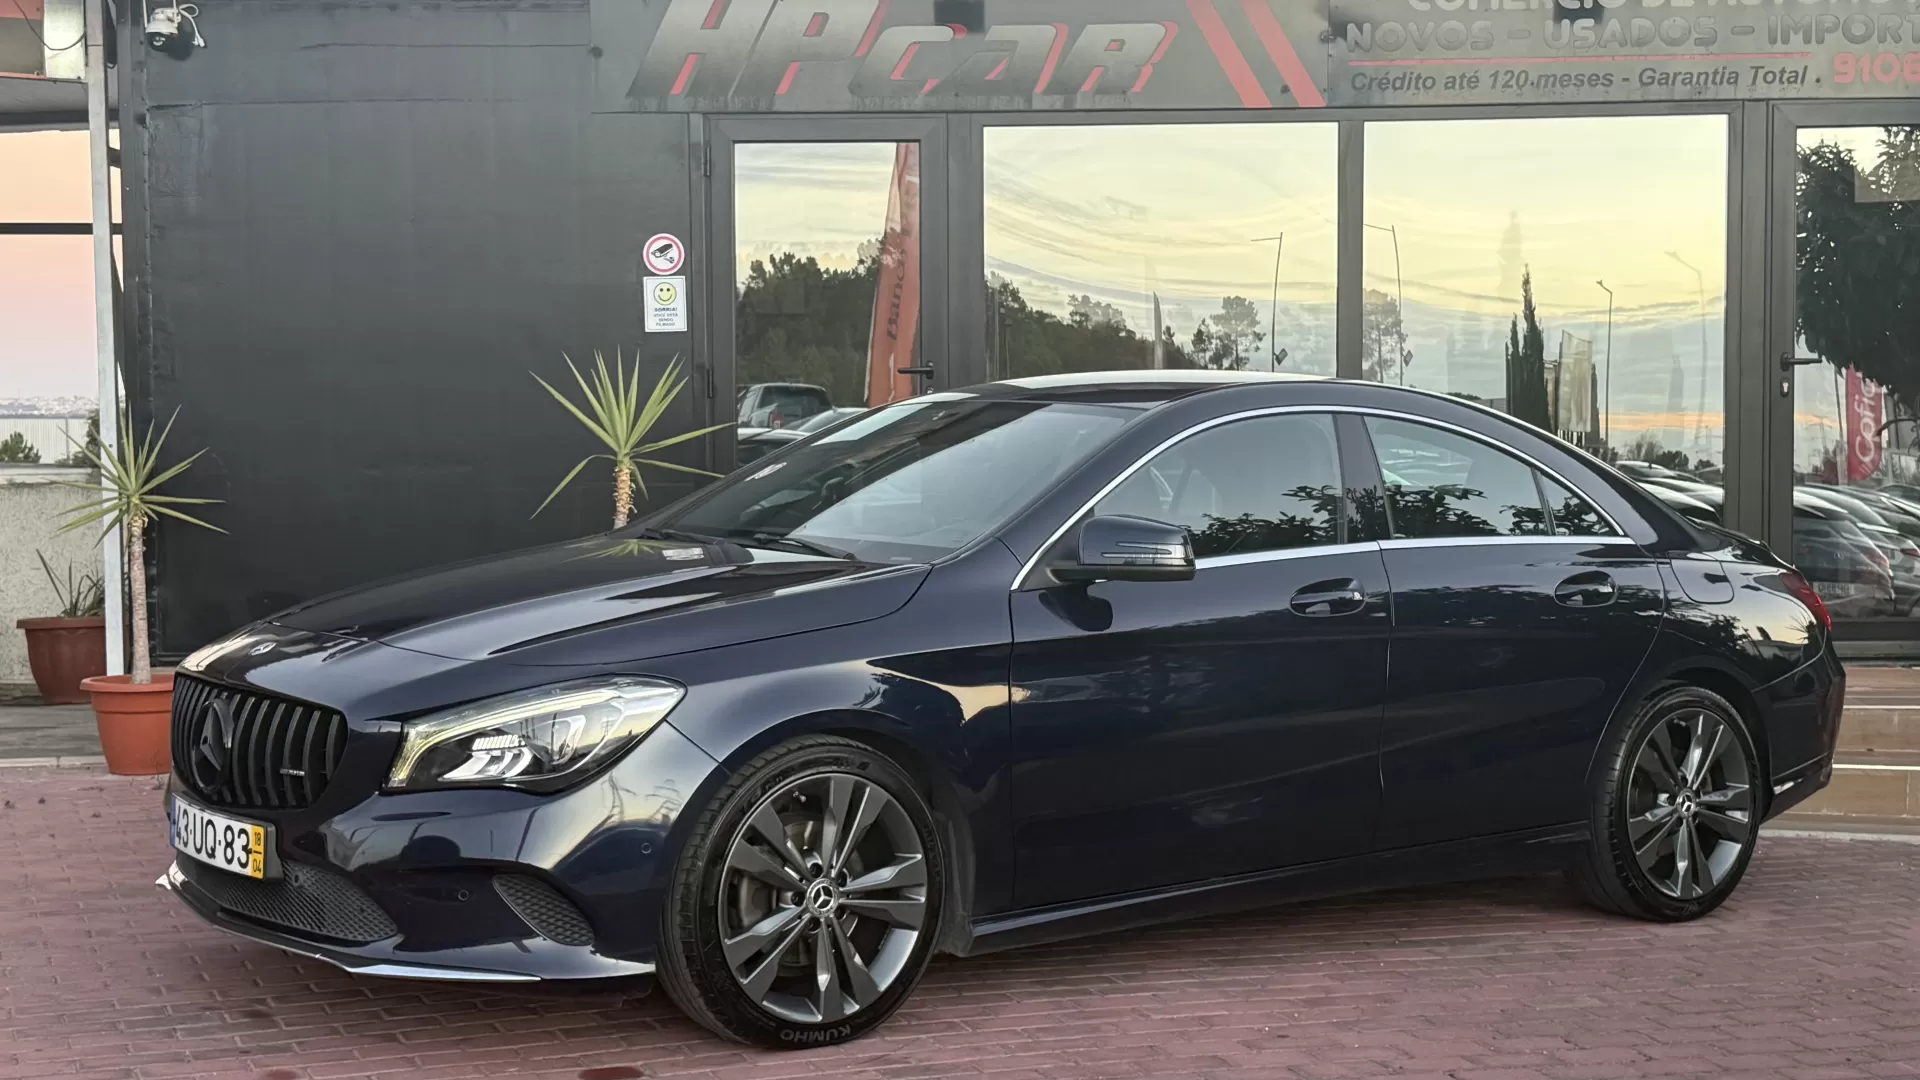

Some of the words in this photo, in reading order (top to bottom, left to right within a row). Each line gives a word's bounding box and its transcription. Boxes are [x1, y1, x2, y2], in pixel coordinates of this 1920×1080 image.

[1346, 20, 1495, 52] NOVOS
[1543, 16, 1718, 51] USADOS
[1351, 71, 1437, 91] Crédito
[1443, 70, 1481, 90] até
[1638, 67, 1740, 87] Garantia
[252, 858, 262, 873] 04
[780, 1023, 852, 1044] KUMHO
